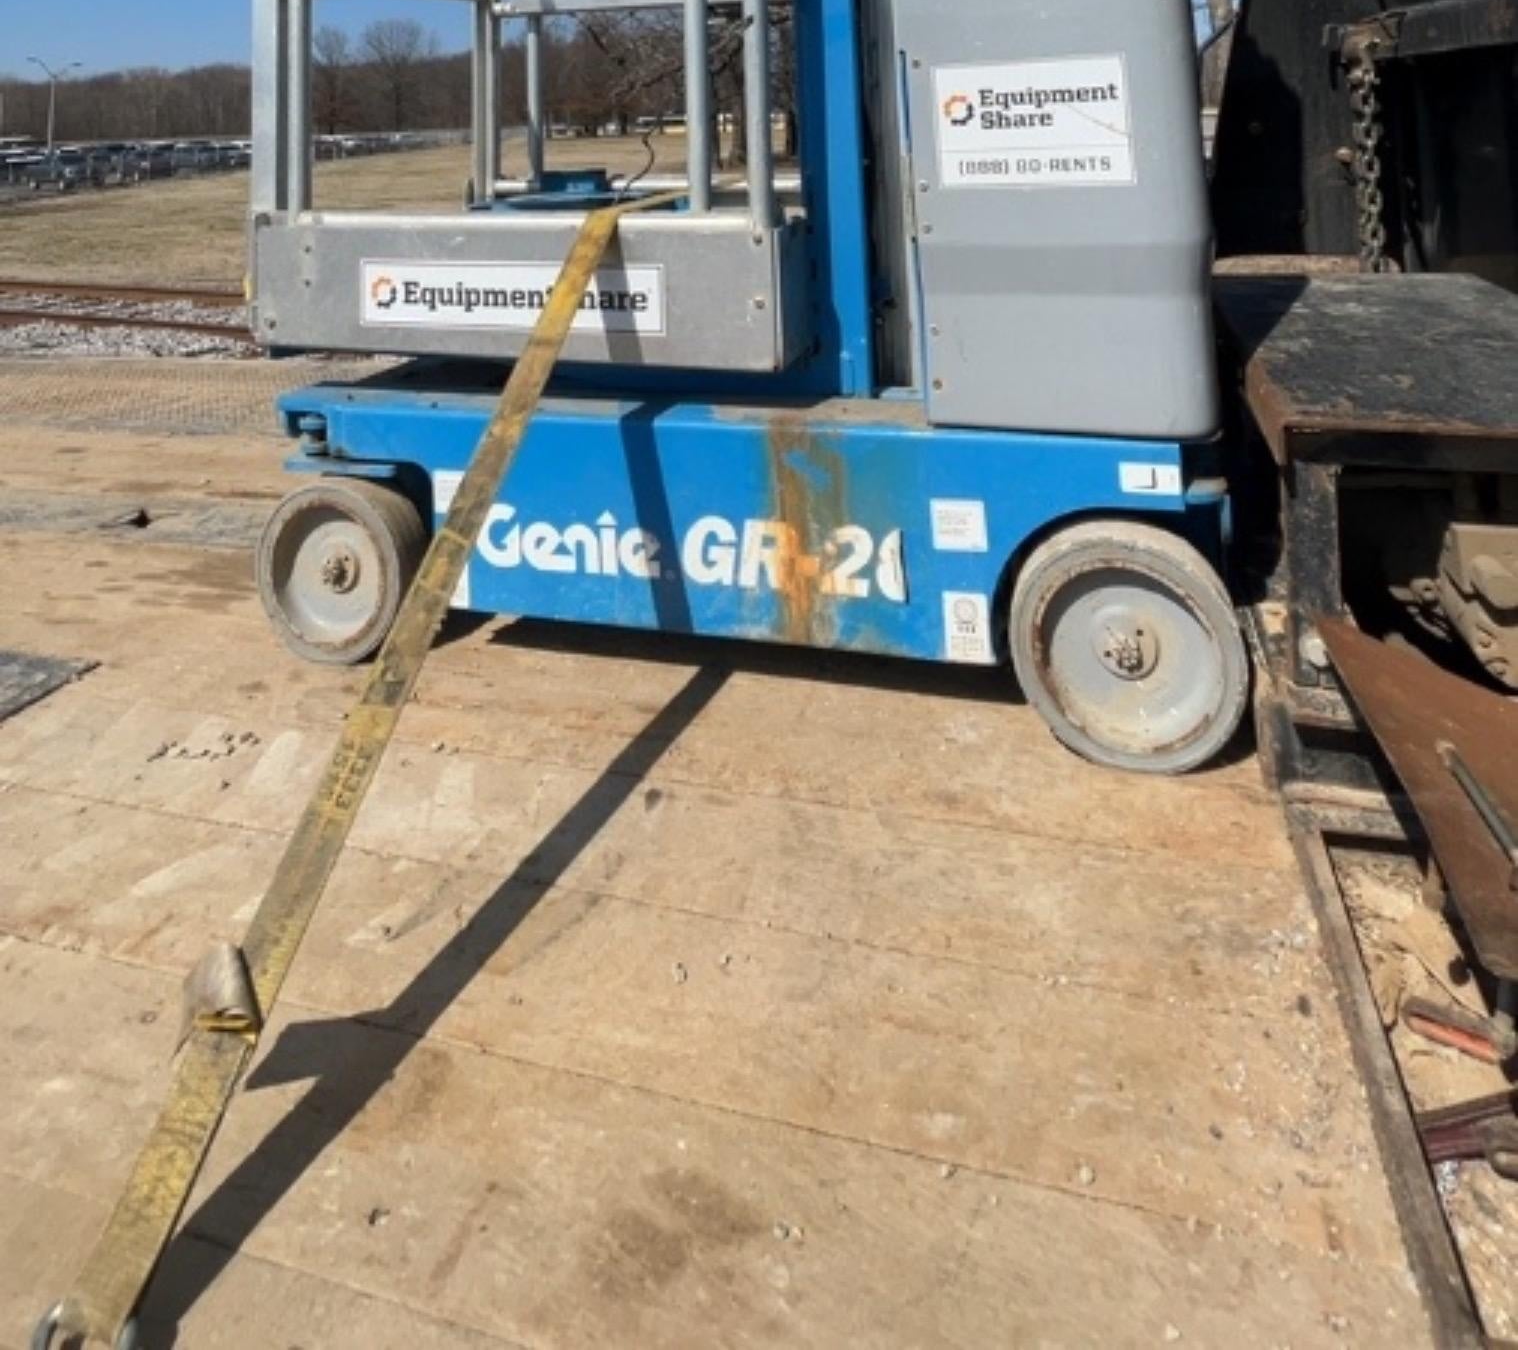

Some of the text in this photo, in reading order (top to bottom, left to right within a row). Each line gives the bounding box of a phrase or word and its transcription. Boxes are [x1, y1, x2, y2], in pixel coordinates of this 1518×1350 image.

[978, 83, 1119, 110] Equipment
[980, 111, 1054, 130] Share
[477, 503, 661, 579] Genie
